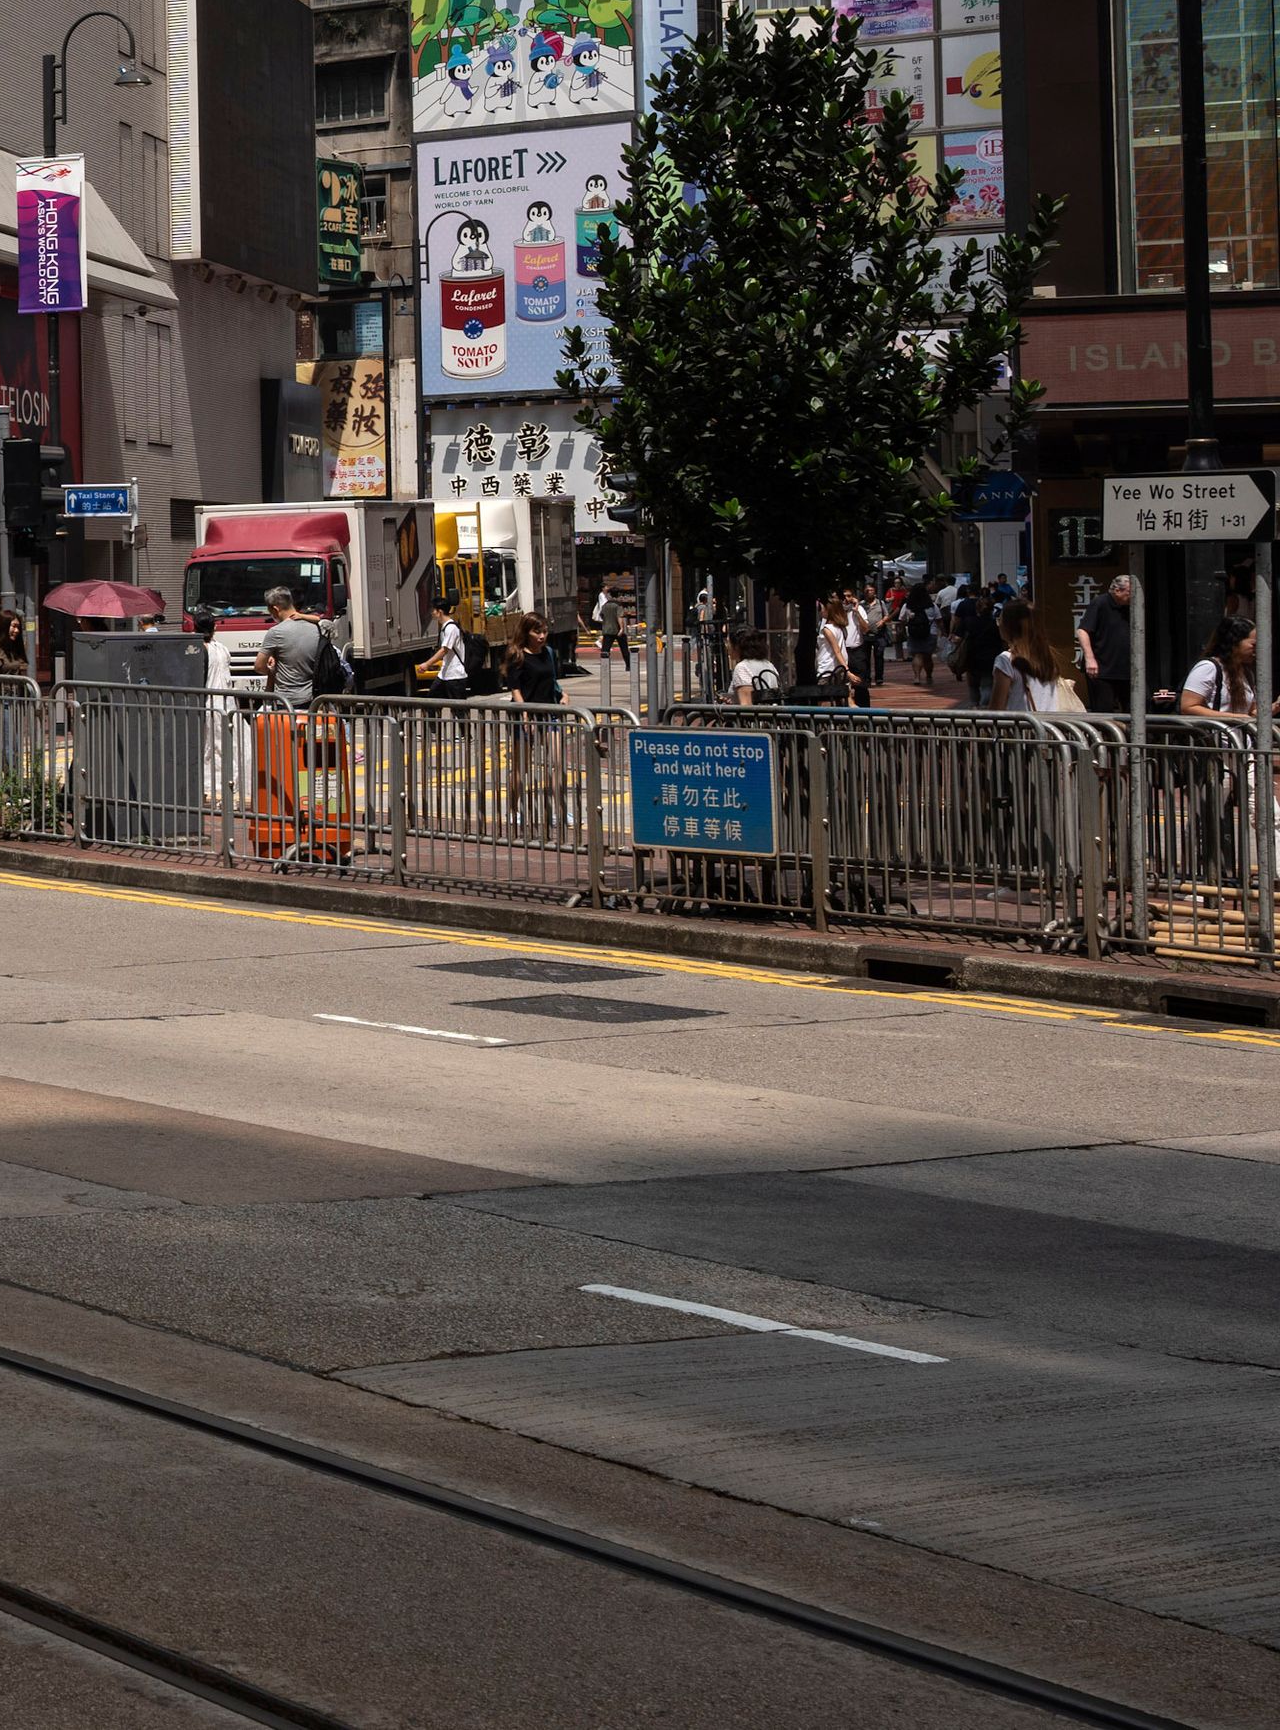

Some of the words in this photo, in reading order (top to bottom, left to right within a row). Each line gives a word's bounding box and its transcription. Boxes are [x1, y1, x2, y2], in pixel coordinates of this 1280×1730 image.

[911, 55, 924, 67] 6/F
[433, 147, 529, 187] LAFORET
[341, 173, 359, 236] 冰室
[433, 191, 473, 201] WELCOME
[482, 188, 490, 196] A
[490, 185, 530, 196] COLORFUL
[434, 200, 457, 210] WORLD
[458, 199, 470, 208] OF
[471, 197, 495, 207] YARN
[37, 199, 45, 235] ASIA'S
[45, 198, 59, 250] HONG
[37, 235, 46, 278] WORLD
[522, 252, 560, 267] Laforet
[46, 252, 60, 305] KONG
[38, 278, 47, 305] CITY
[450, 287, 498, 306] Laforet
[523, 293, 561, 307] TOMATO
[454, 302, 494, 312] CONDENSED
[526, 304, 557, 316] SOUP
[451, 343, 499, 358] TOMATO
[457, 355, 494, 370] SOUP
[328, 364, 386, 401] 最強
[324, 399, 383, 438] 藥妝
[462, 421, 553, 468] 德彰
[77, 491, 93, 501] Taxi
[93, 491, 116, 501] Stand
[449, 471, 568, 500] 中西藥業
[1111, 484, 1142, 500] Yee
[1149, 483, 1175, 499] Wo
[1182, 482, 1237, 500] Street
[81, 501, 113, 512] 的士站
[1135, 508, 1210, 532] 怡和街
[1220, 515, 1247, 527] 1-31
[634, 739, 680, 756] Please
[683, 741, 701, 757] do
[704, 743, 729, 758] not
[732, 744, 764, 762] stop
[653, 760, 679, 775] and
[681, 761, 712, 777] wait
[715, 762, 747, 778] here
[660, 783, 742, 809] 請勿在此
[662, 814, 743, 842] 停車等候
